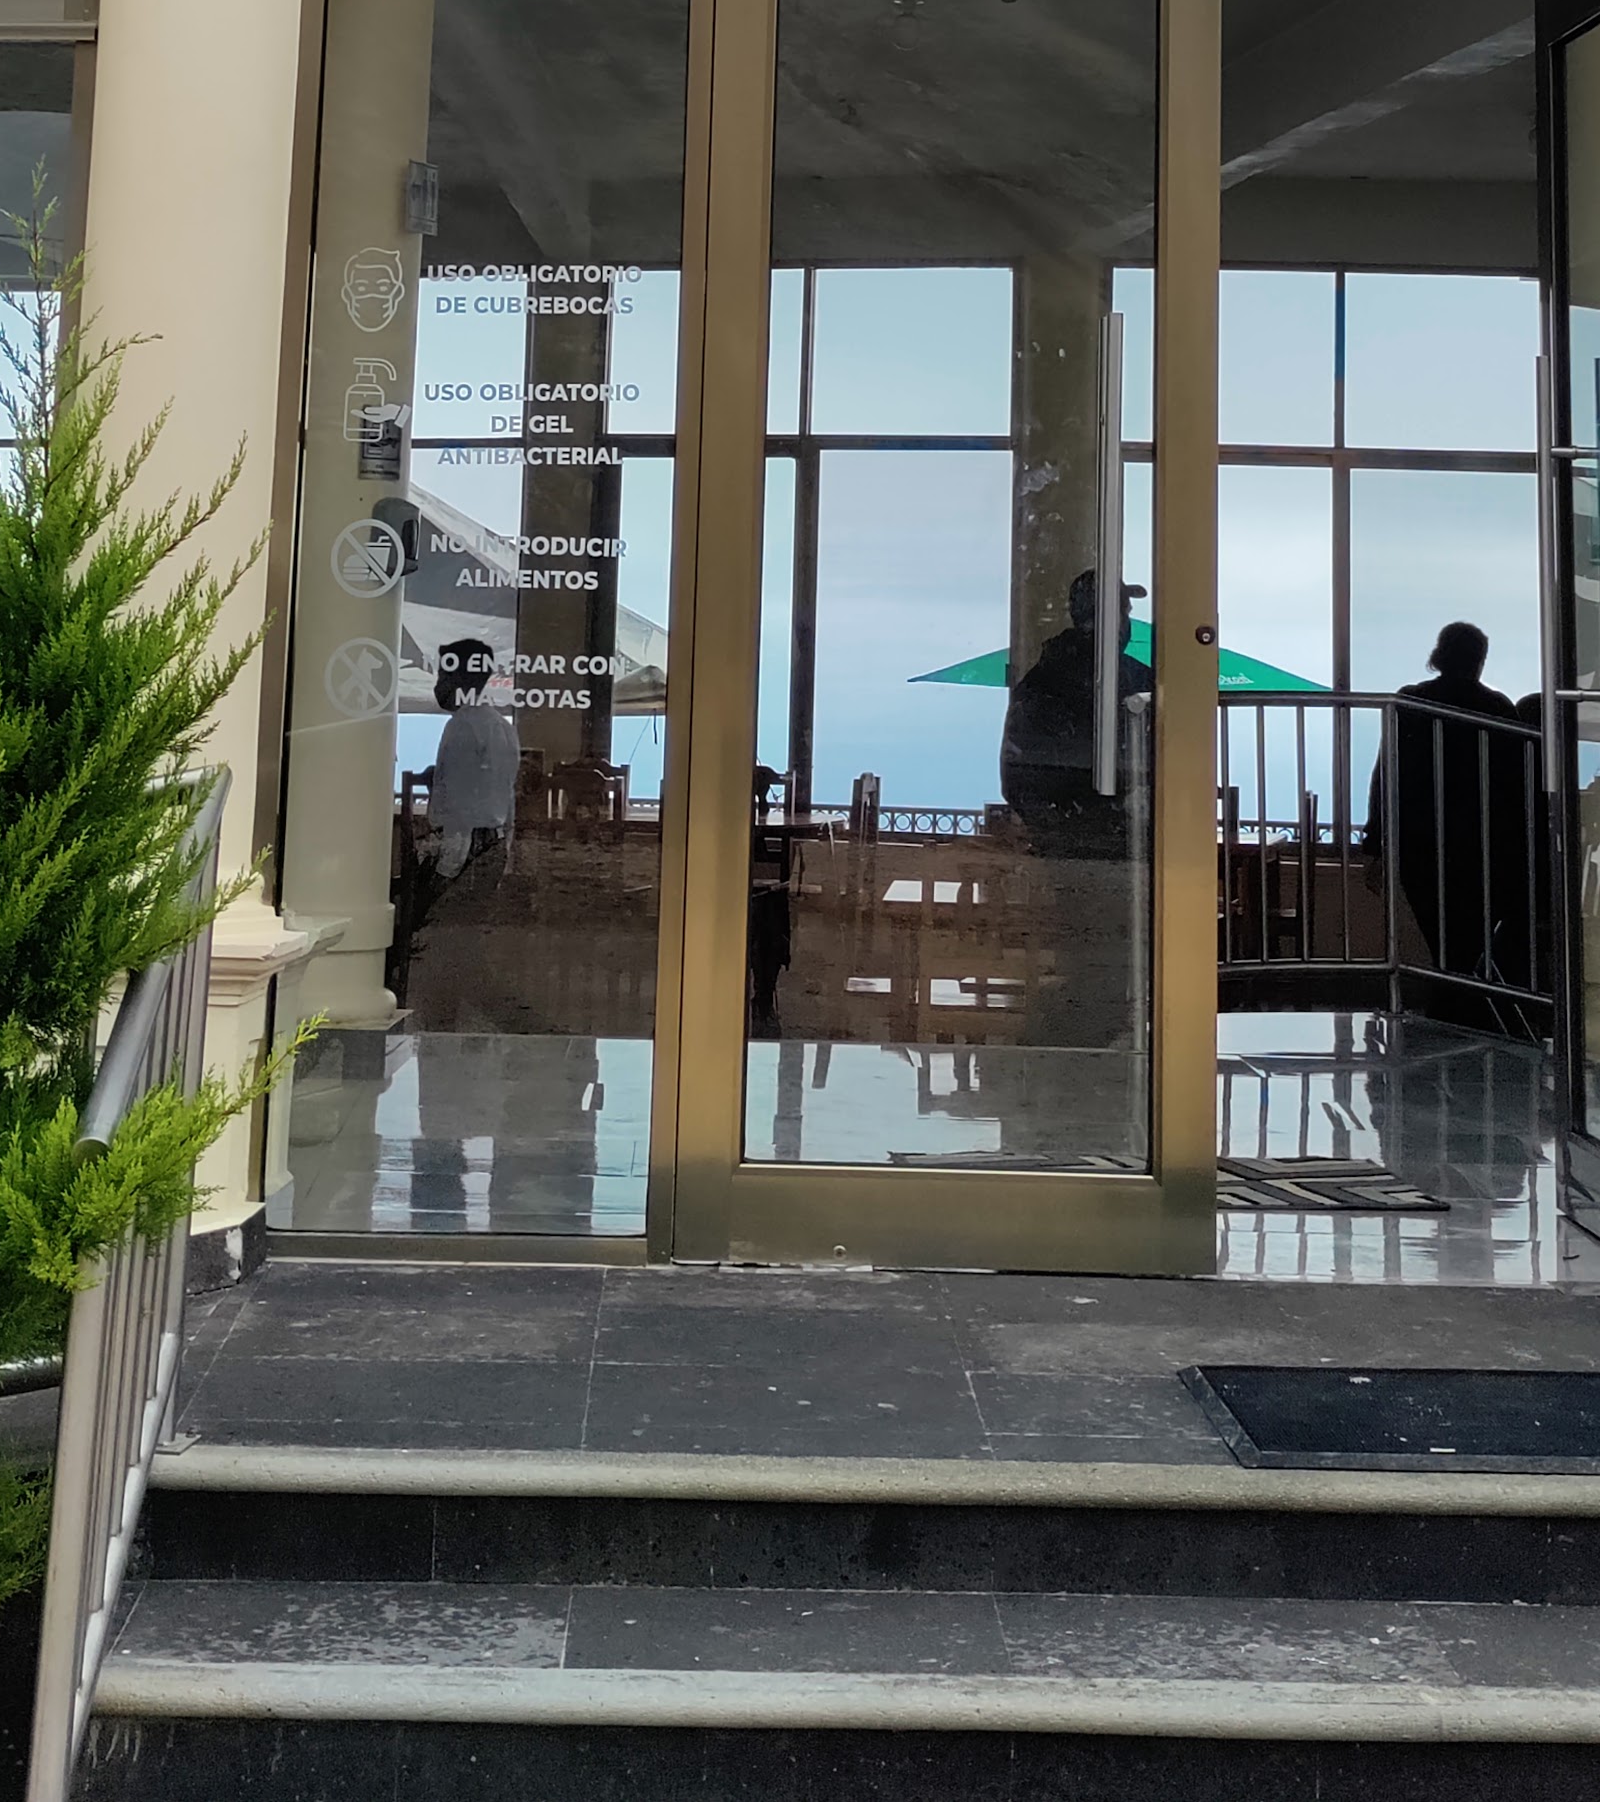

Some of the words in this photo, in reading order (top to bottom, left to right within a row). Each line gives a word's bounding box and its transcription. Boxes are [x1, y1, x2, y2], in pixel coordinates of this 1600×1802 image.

[427, 264, 476, 282] USO
[482, 265, 642, 283] OBLIGATORIO
[436, 297, 467, 314] DE
[474, 296, 633, 315] CUBREBOCAS
[424, 384, 472, 401] USO
[480, 384, 640, 402] OBLIGATORIO
[491, 416, 522, 433] DE
[529, 415, 574, 433] GEL
[438, 447, 623, 465] ANTIBACTERIAL
[430, 534, 467, 553] NO
[475, 535, 627, 558] INTRODUCIR
[456, 568, 599, 590] ALIMENTOS
[422, 652, 460, 672] NO
[467, 653, 566, 675] ENTRAR
[572, 656, 626, 676] CON
[455, 687, 591, 710] MASCOTAS
